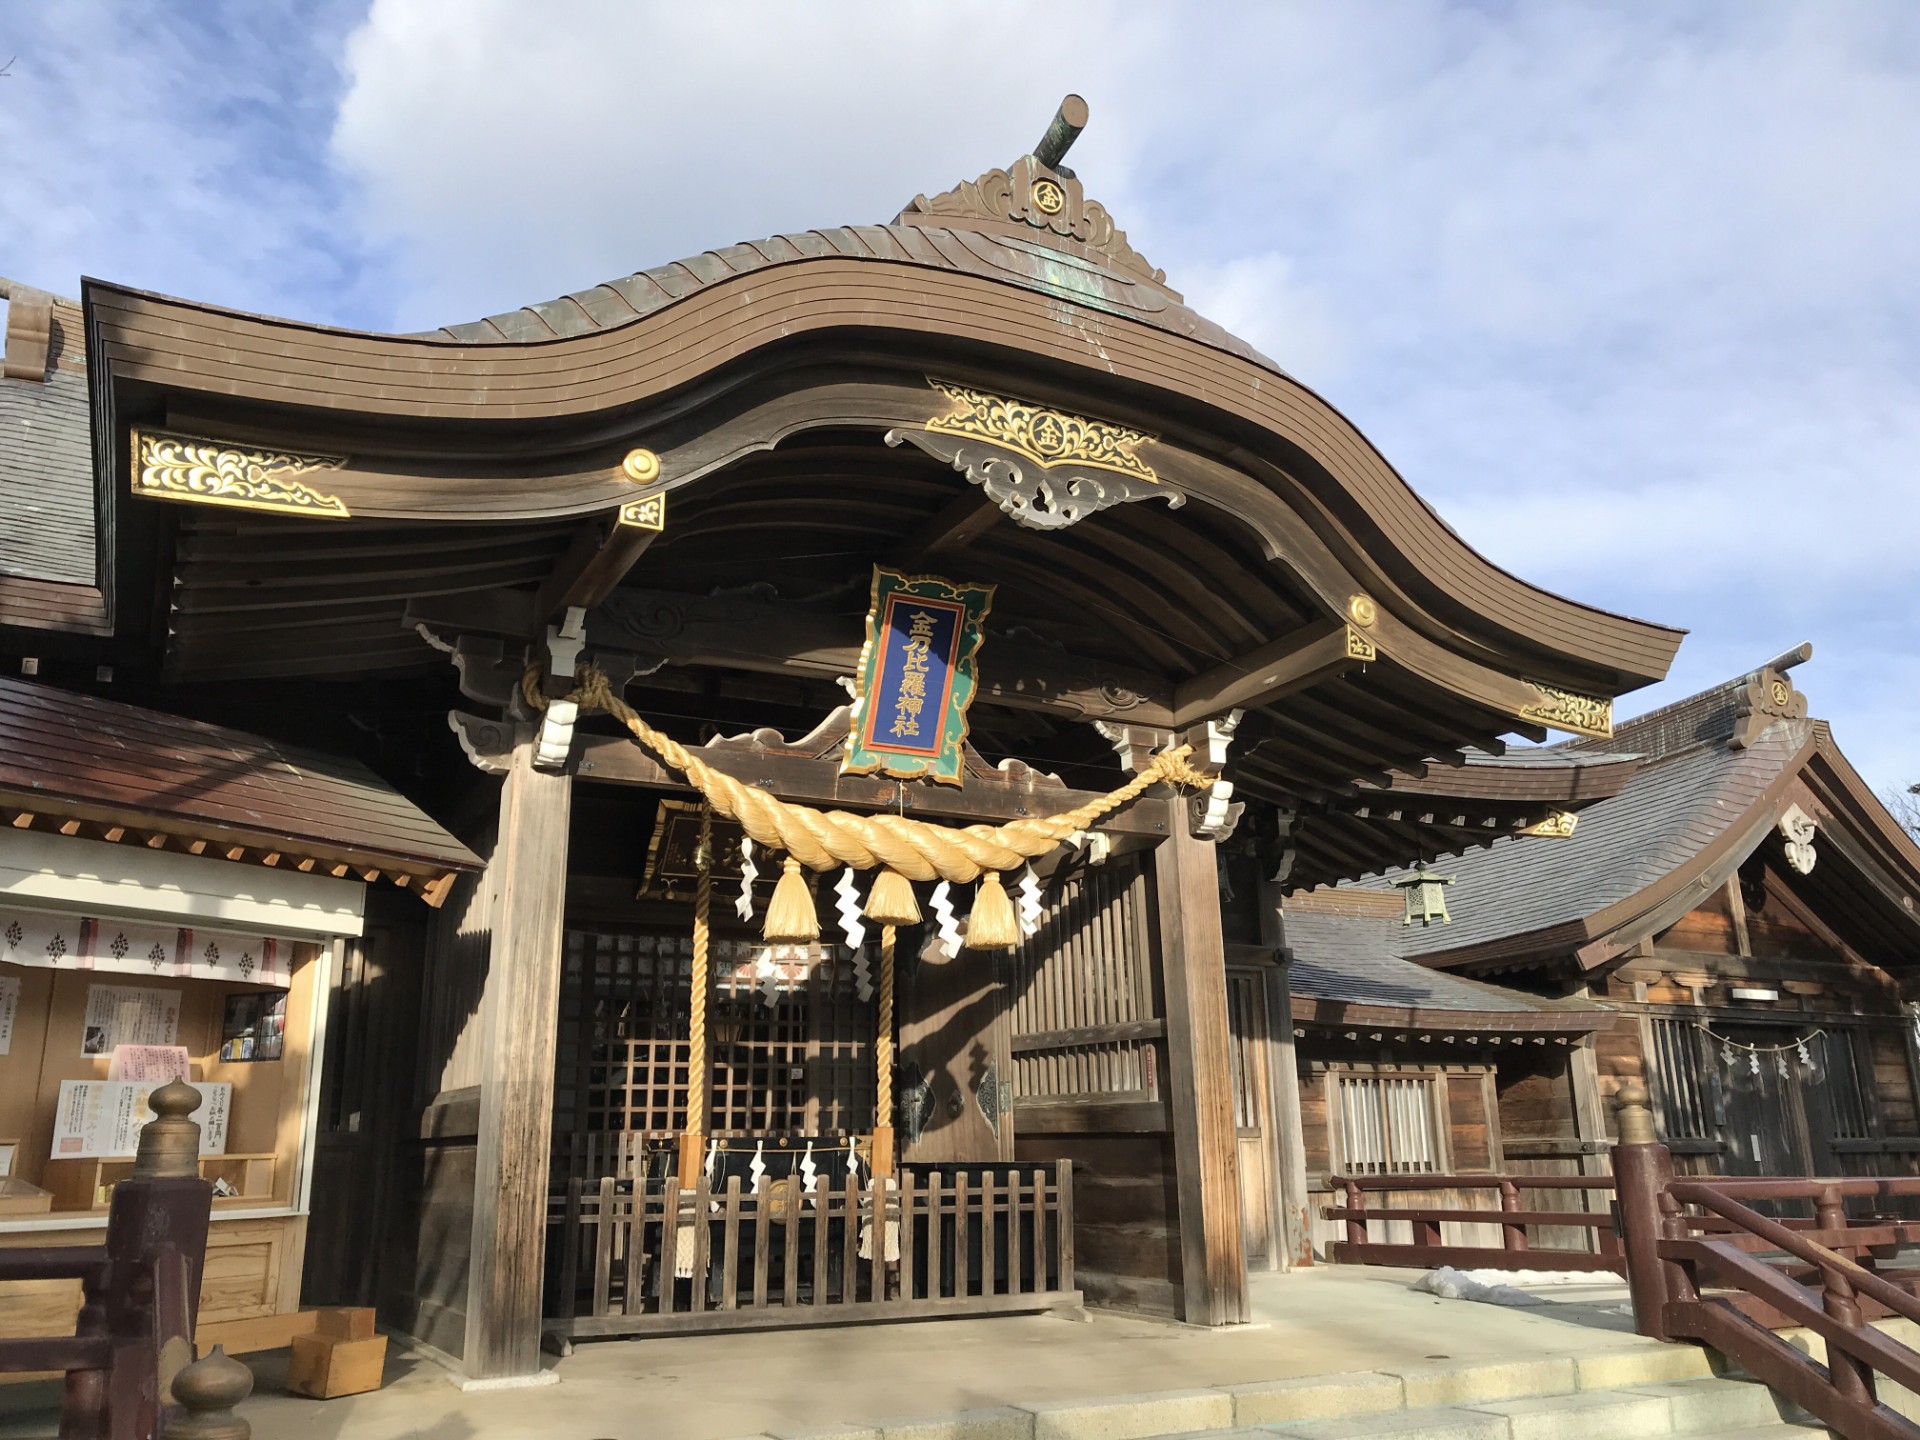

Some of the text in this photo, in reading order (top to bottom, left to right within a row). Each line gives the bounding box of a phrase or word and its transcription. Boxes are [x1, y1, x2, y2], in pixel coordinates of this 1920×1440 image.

[1038, 185, 1060, 209] 金
[1033, 415, 1064, 449] 金
[889, 610, 939, 738] 金刀比羅神社
